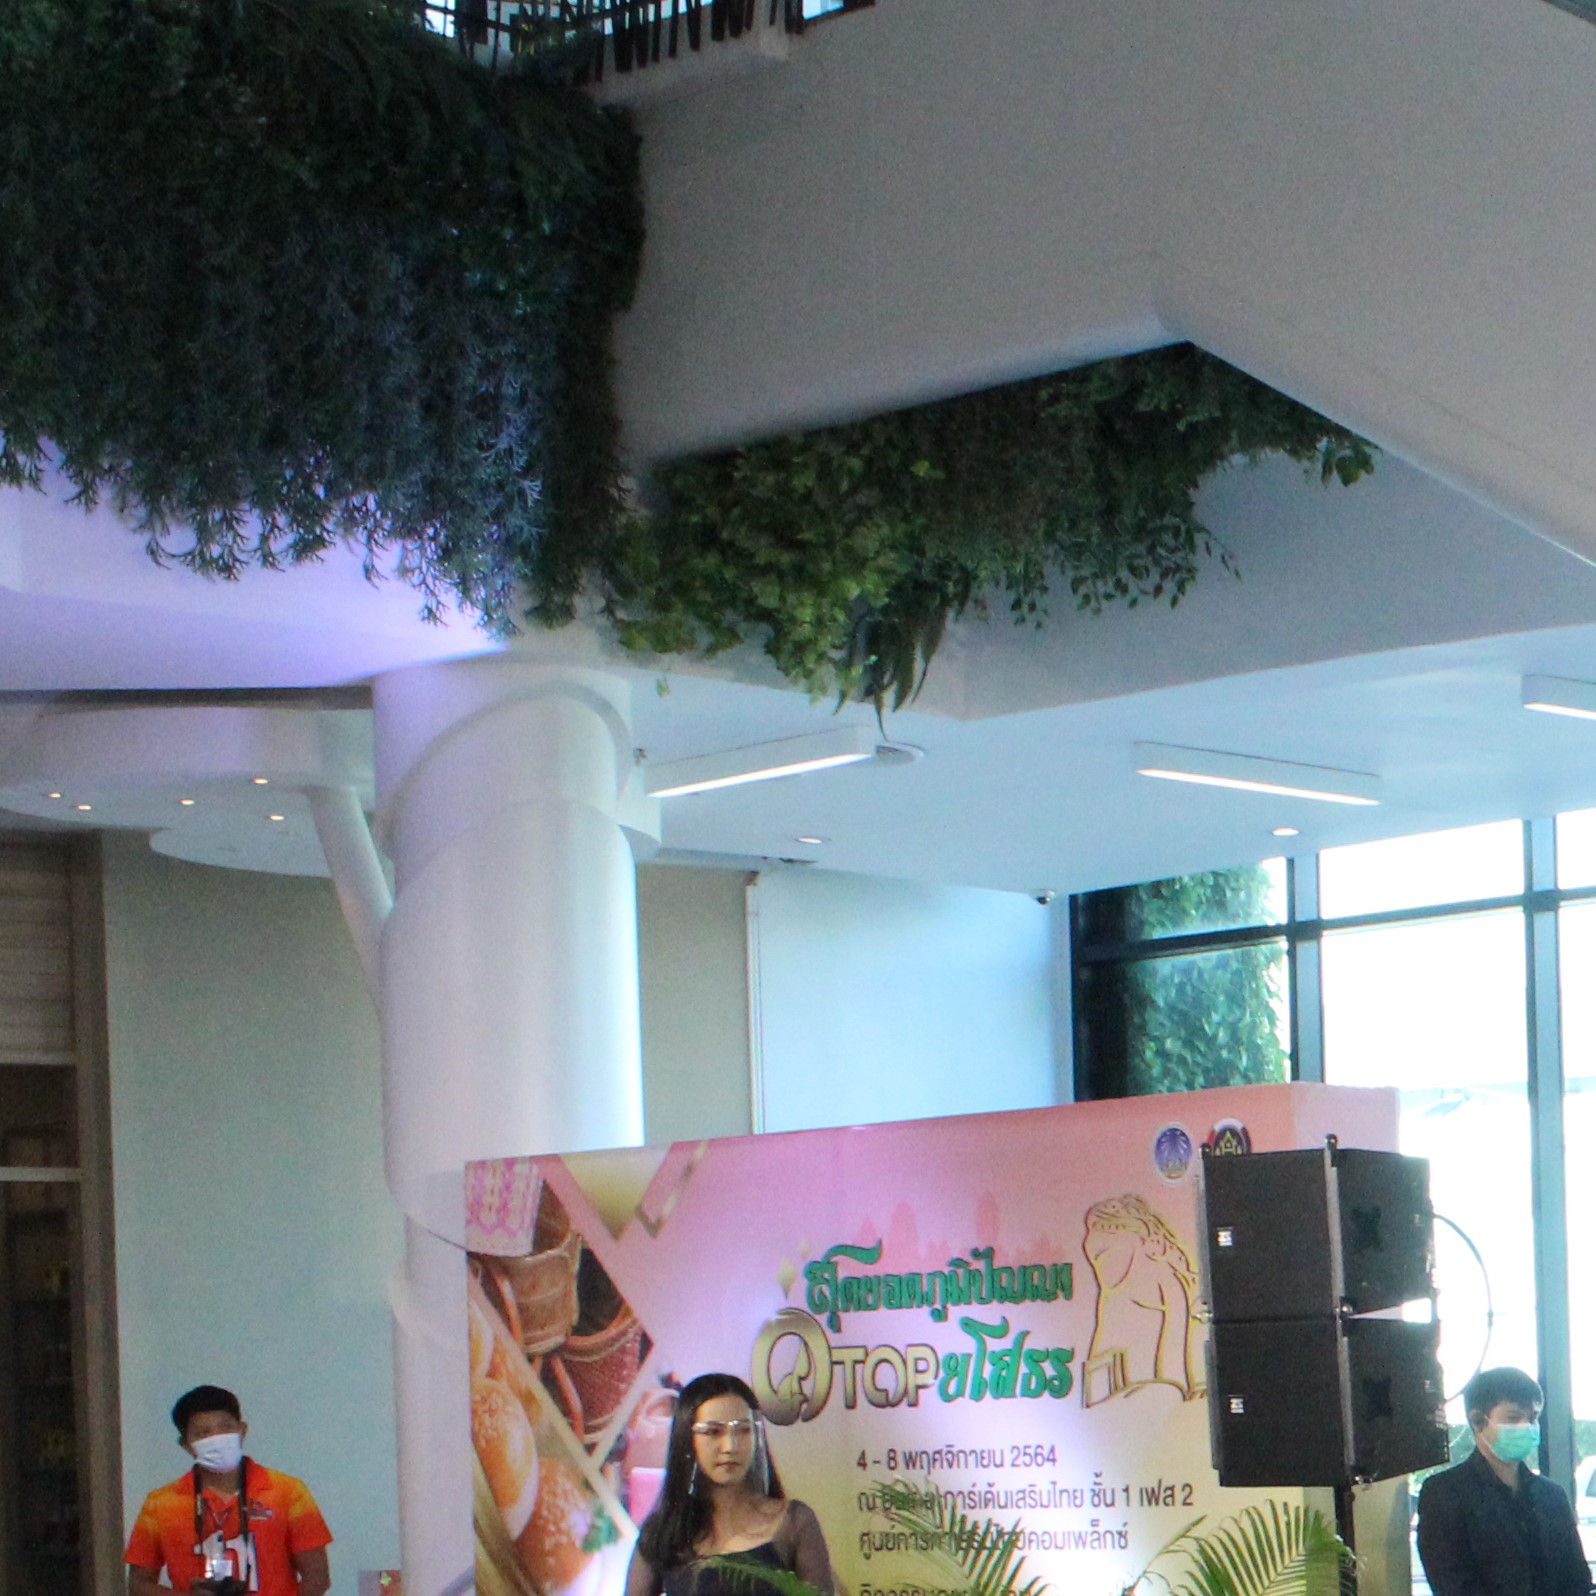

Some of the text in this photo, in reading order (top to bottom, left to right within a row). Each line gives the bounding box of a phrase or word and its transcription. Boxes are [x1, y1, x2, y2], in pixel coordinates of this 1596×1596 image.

[804, 1239, 1073, 1333] สุดยอดภูมิปัญญา
[751, 1307, 1074, 1426] OTOP ยโสธร
[857, 1449, 868, 1470] 4
[887, 1449, 898, 1470] 8
[903, 1444, 1004, 1474] พฤศจิกายน
[1011, 1445, 1057, 1467] 2564
[858, 1491, 875, 1512] ณ
[1090, 1471, 1115, 1507] ชั้น
[1122, 1486, 1131, 1507] 1
[1139, 1478, 1176, 1508] เฟส
[1181, 1484, 1194, 1507] 2
